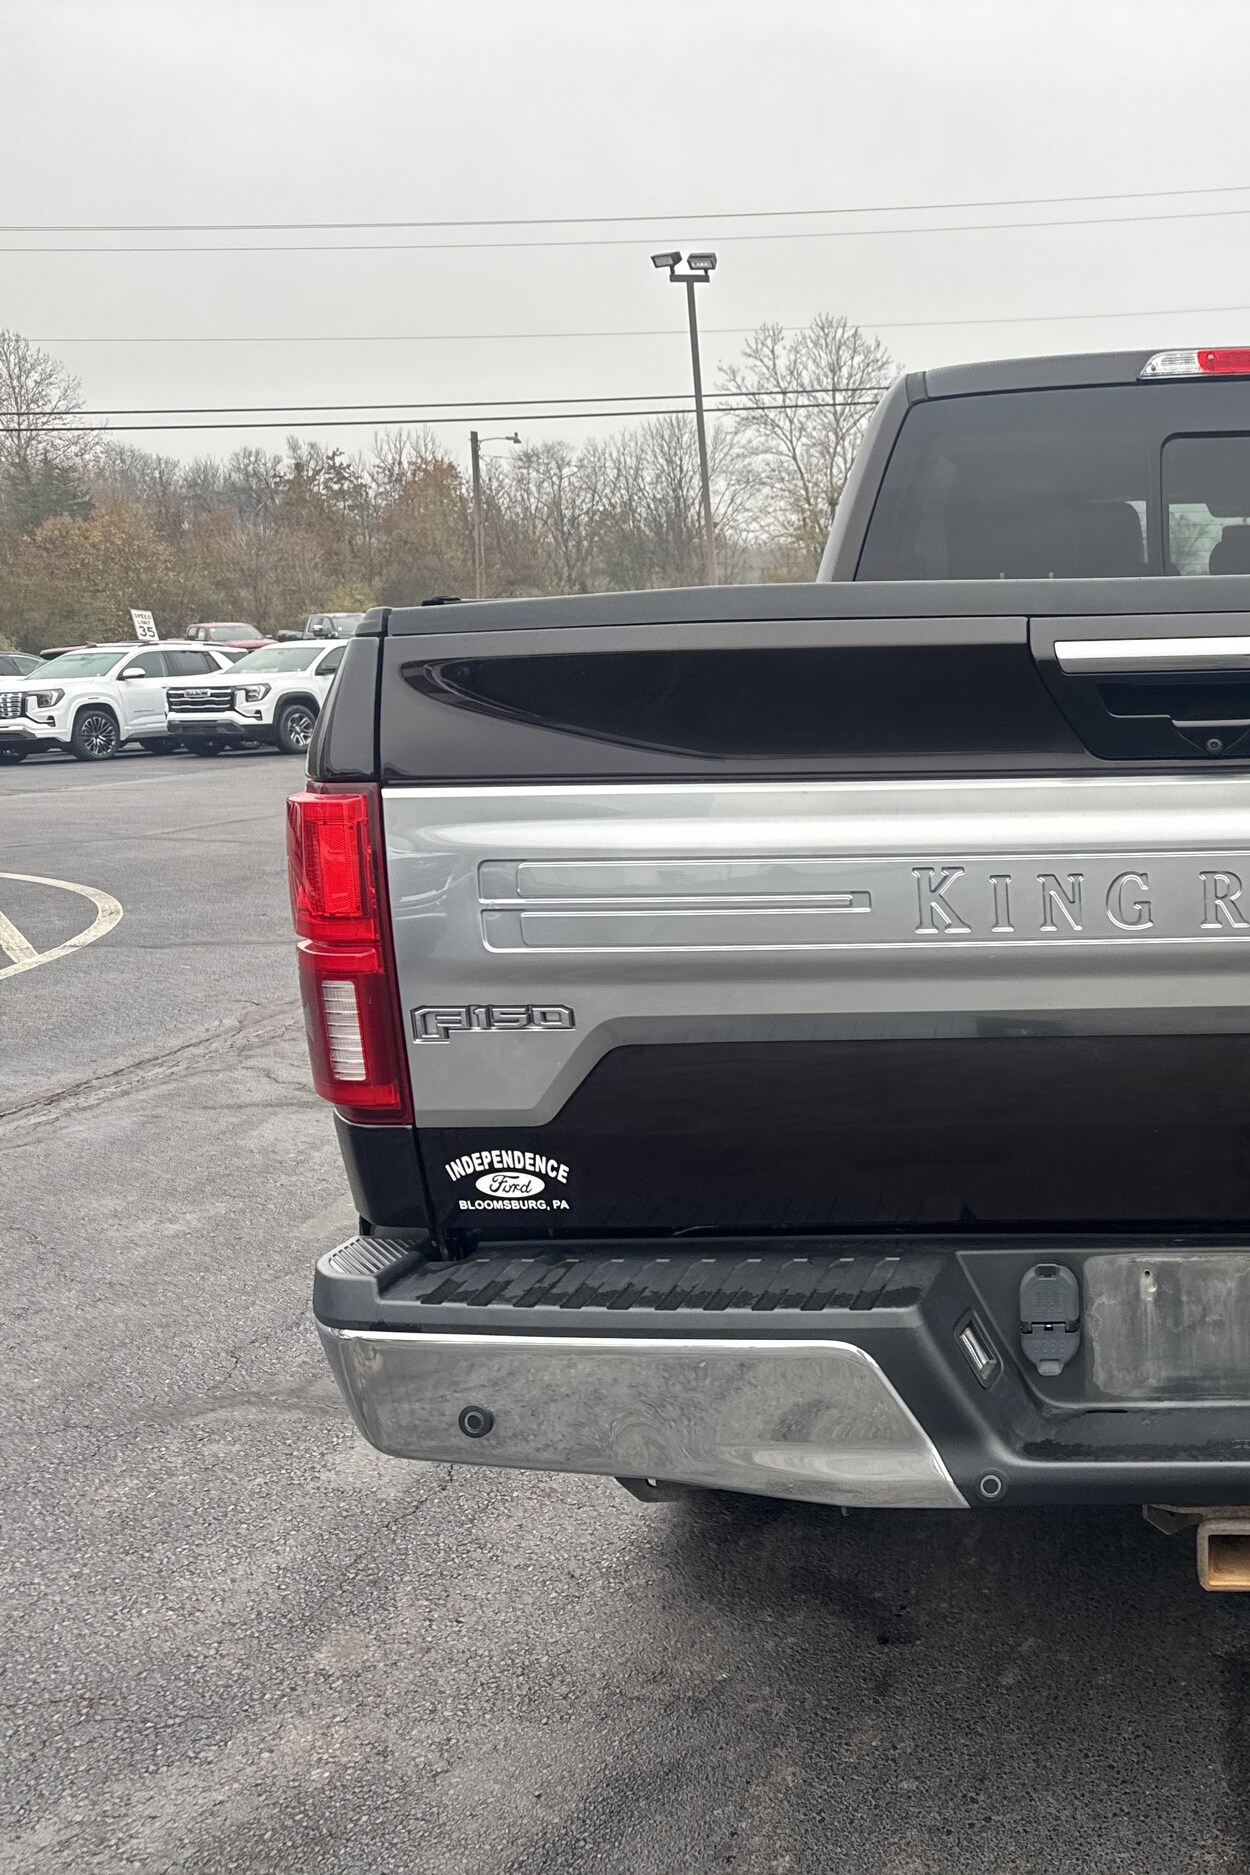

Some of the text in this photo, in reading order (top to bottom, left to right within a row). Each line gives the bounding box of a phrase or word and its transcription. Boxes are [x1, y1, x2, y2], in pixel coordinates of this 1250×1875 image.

[138, 625, 156, 638] 35
[911, 866, 1154, 934] KING
[445, 1150, 570, 1184] INDEPENDENCE
[489, 1174, 533, 1194] Ford
[458, 1200, 570, 1211] BLOOMSBURG, PA
